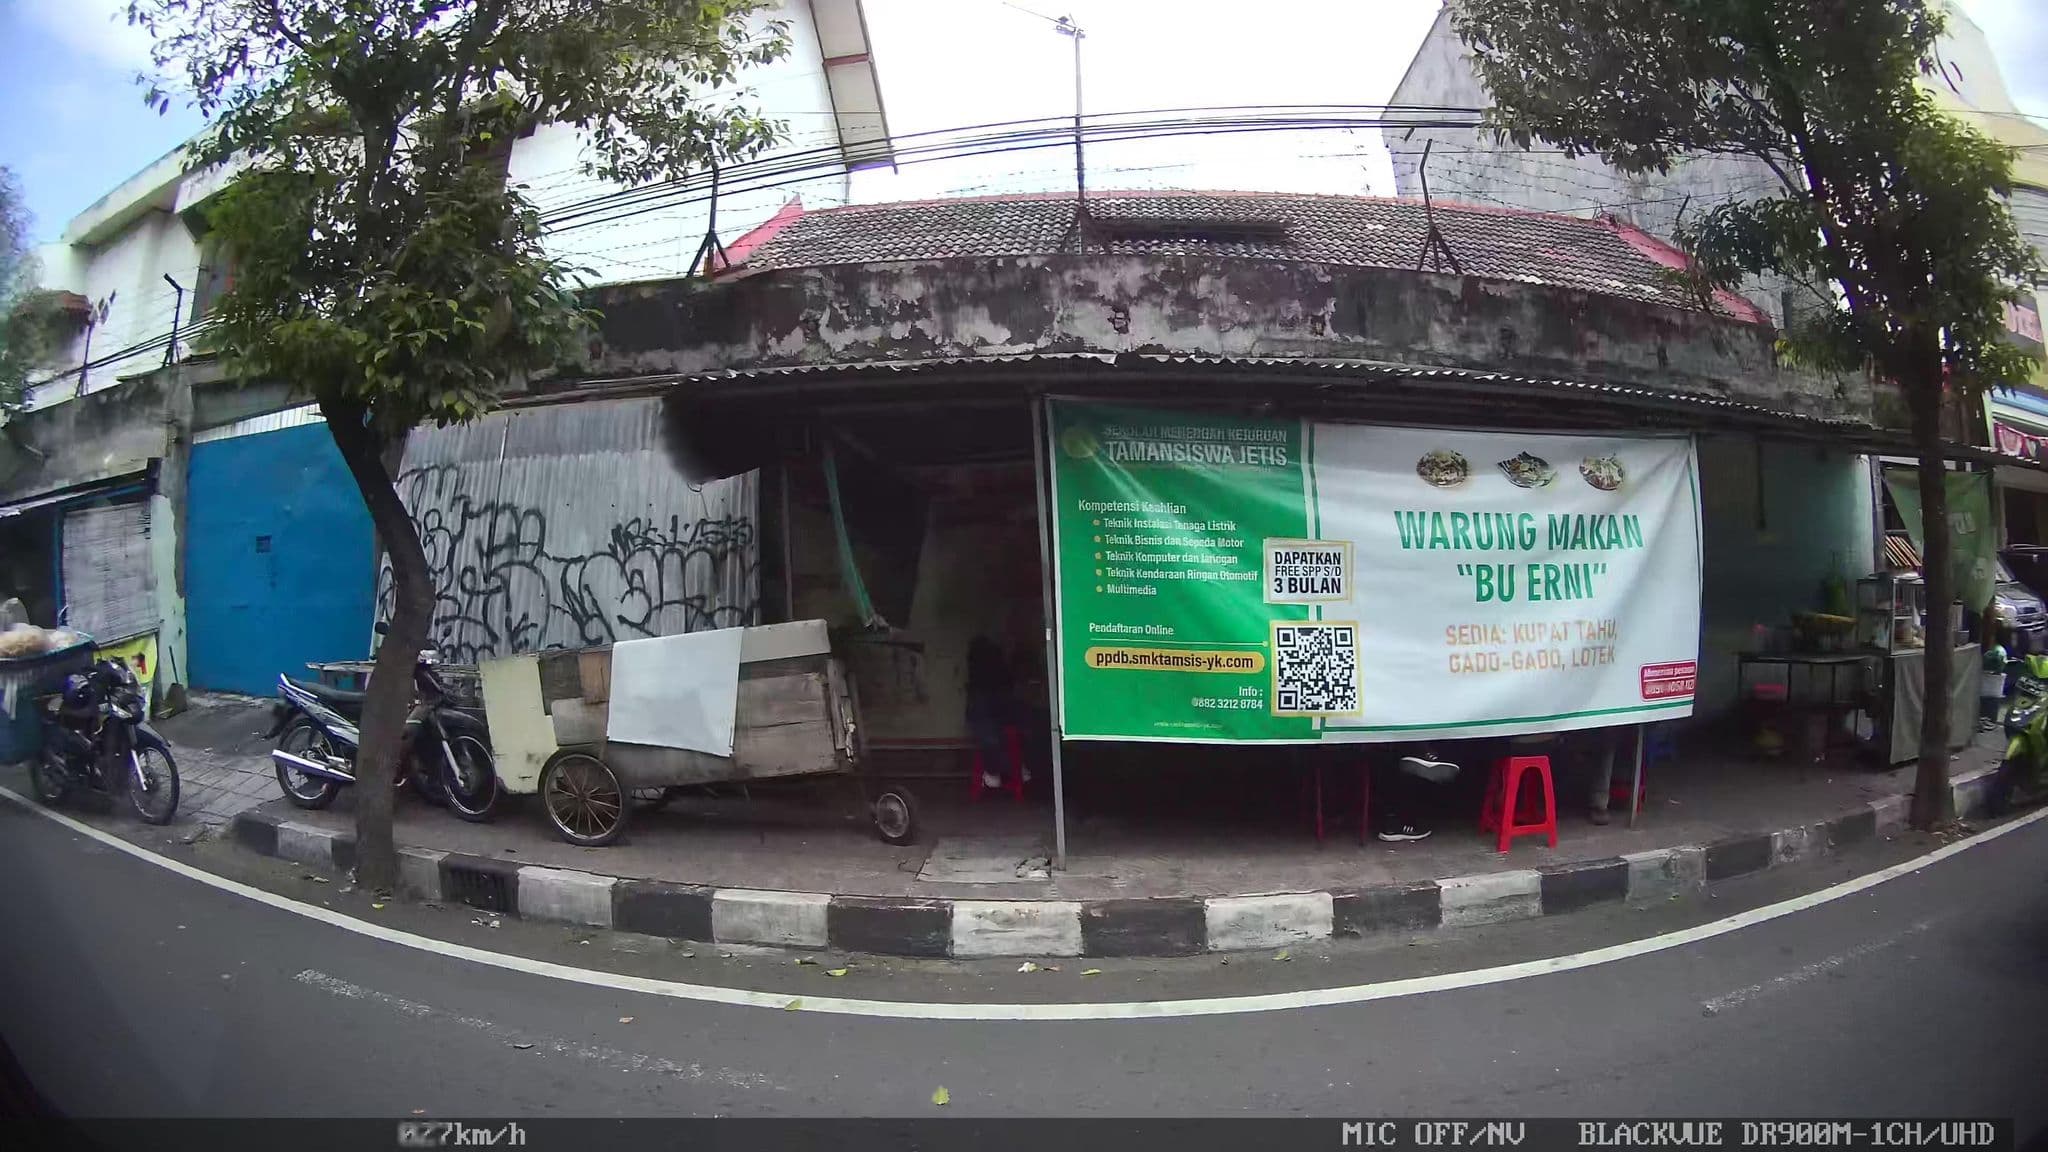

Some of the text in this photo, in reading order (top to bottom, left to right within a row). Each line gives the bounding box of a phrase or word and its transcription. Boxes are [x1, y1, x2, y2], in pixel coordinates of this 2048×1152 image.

[1228, 428, 1287, 443] KEJURUAN
[1105, 440, 1288, 466] TAMANSISWA JETIS
[1078, 499, 1140, 515] Kompetensi
[1104, 518, 1133, 529] Teknik
[1174, 520, 1206, 532] Tenaga
[1208, 521, 1236, 532] Listrik
[1393, 510, 1645, 551] WARUNG MAKAN
[1105, 534, 1245, 549] Teknik Bisnis dan Sepeda Motor
[1106, 551, 1133, 562] Teknik
[1135, 552, 1180, 564] Komputer
[1182, 552, 1198, 563] dan
[1274, 551, 1341, 565] DAPATKAN
[1106, 567, 1258, 582] Teknik Kendaraan Ringan Otomotif
[1275, 565, 1342, 577] FREE SPP S/D
[1107, 584, 1157, 596] Multimedia
[1274, 577, 1341, 594] 3 BULAN
[1456, 562, 1608, 603] "BU ERNI"
[1089, 622, 1174, 635] Pendaftaran Online
[1445, 623, 1507, 646] SEDIA:
[1513, 620, 1571, 645] KUPAT
[1096, 649, 1254, 670] ppdb.smktamsis-yk.com
[1449, 644, 1617, 674] GADO-GADO, LOTEK
[1239, 686, 1258, 697] Info
[1217, 698, 1239, 709] 3212
[1240, 699, 1263, 710] 8784
